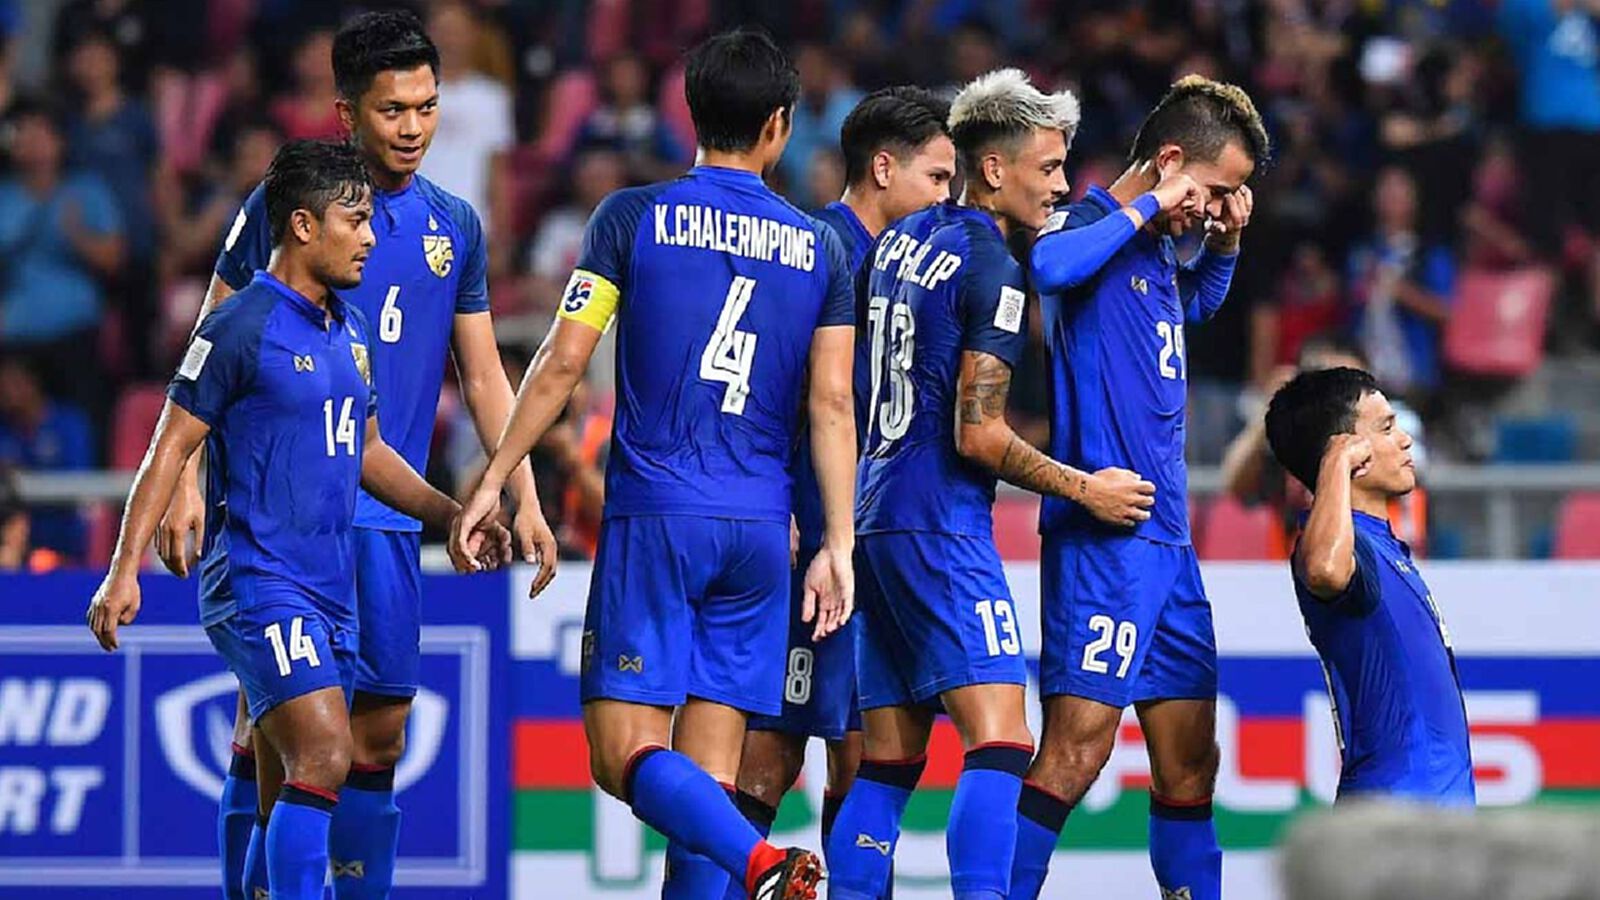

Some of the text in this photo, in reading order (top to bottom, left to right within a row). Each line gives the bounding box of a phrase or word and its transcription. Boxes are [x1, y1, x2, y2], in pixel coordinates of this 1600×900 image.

[655, 204, 816, 272] K.CHALERMPONG
[379, 285, 402, 343] 6
[700, 275, 758, 416] 4
[868, 296, 916, 440] 13
[324, 396, 356, 457] 14
[265, 616, 320, 676] 14
[975, 600, 1020, 657] 13
[1081, 614, 1137, 680] 29
[785, 647, 814, 705] 8
